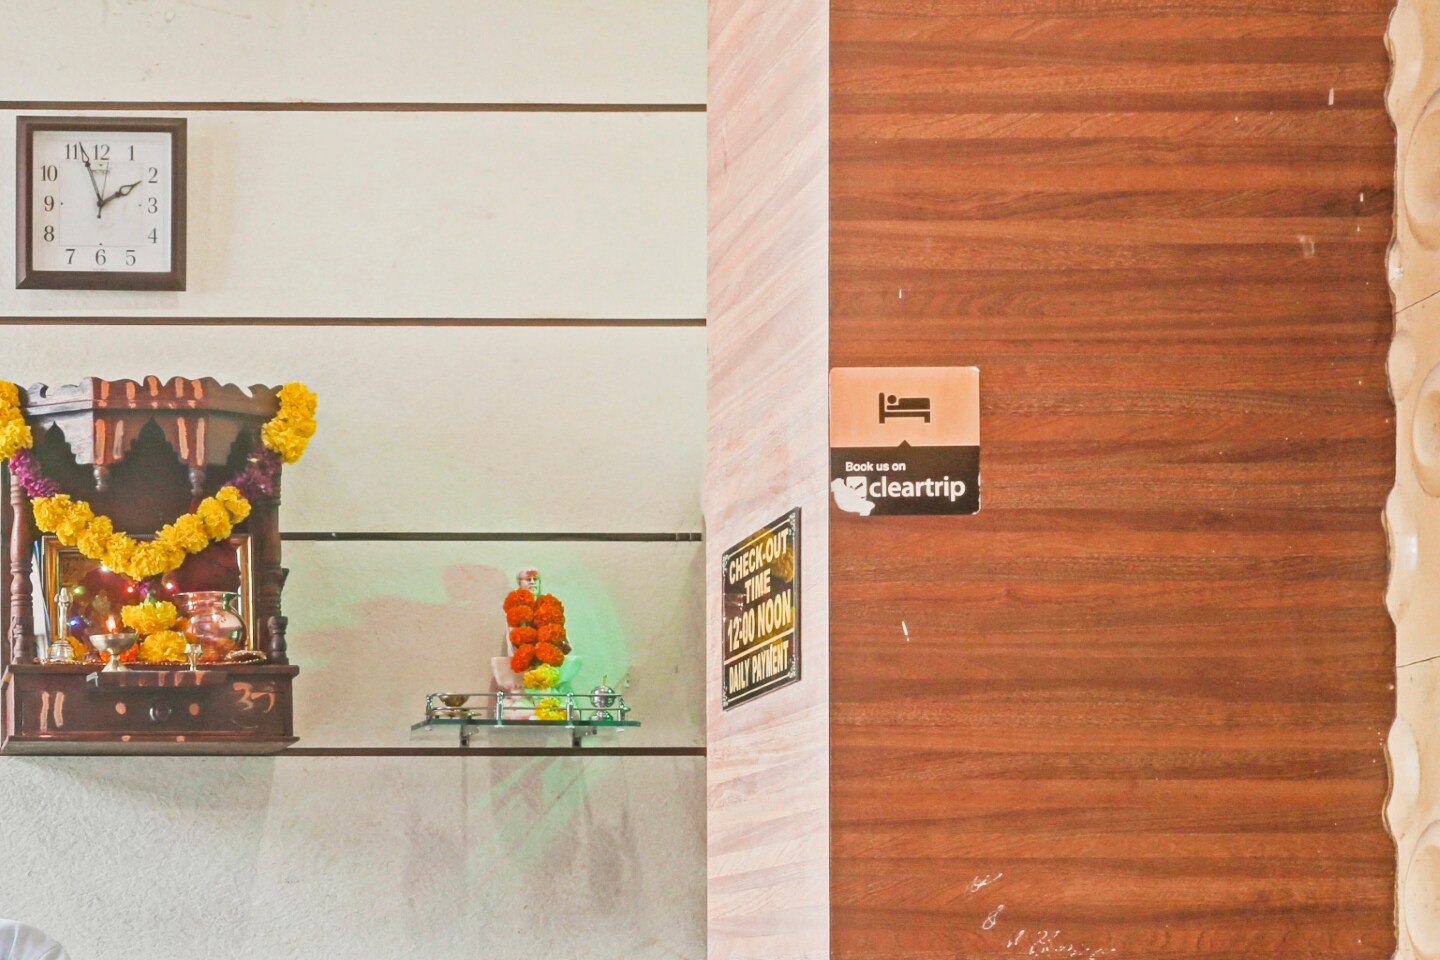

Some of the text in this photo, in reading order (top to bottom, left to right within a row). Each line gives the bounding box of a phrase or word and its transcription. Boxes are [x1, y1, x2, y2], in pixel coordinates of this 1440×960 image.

[65, 144, 135, 161] 11 12 1
[40, 165, 58, 182] 10
[148, 167, 158, 184] 2
[44, 195, 55, 212] 9
[147, 197, 158, 214] 3
[43, 225, 55, 242] 8
[147, 227, 158, 244] 4
[65, 248, 136, 266] 7 6 5
[845, 461, 906, 472] Book us on
[869, 475, 966, 502] cleartrip
[729, 527, 789, 585] CHECK-OUT
[744, 568, 771, 604] TIME
[728, 589, 791, 652] 12:00 NOON
[729, 640, 789, 694] DAILY PAYMENT
